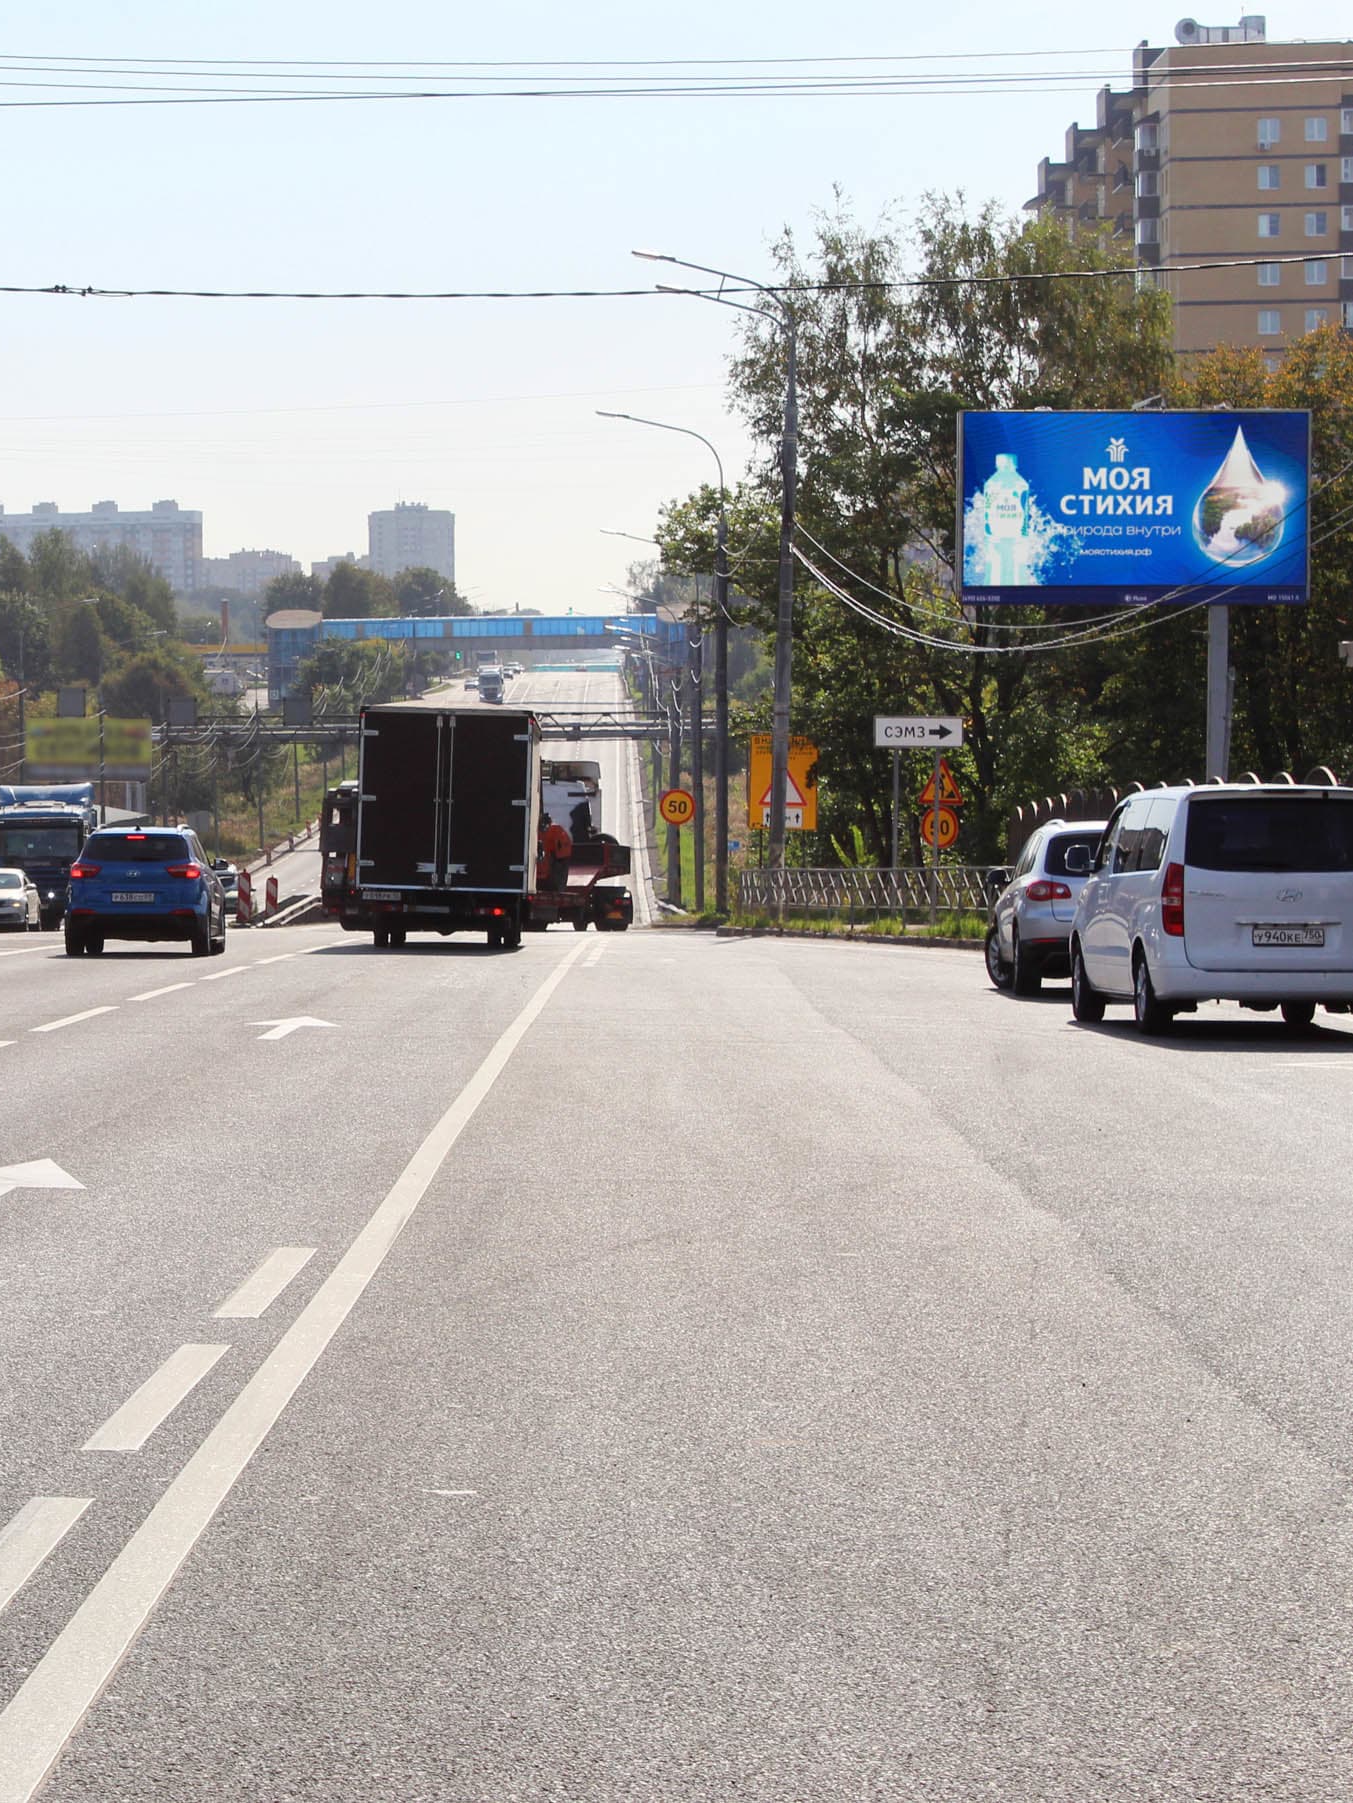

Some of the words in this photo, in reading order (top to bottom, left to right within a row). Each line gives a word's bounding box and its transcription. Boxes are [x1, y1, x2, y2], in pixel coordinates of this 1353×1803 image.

[1082, 467, 1151, 490] МОЯ
[1059, 495, 1174, 515] СТИХИЯ
[1125, 525, 1182, 538] внутри
[884, 726, 926, 738] СЭМЗ
[668, 800, 688, 814] 50
